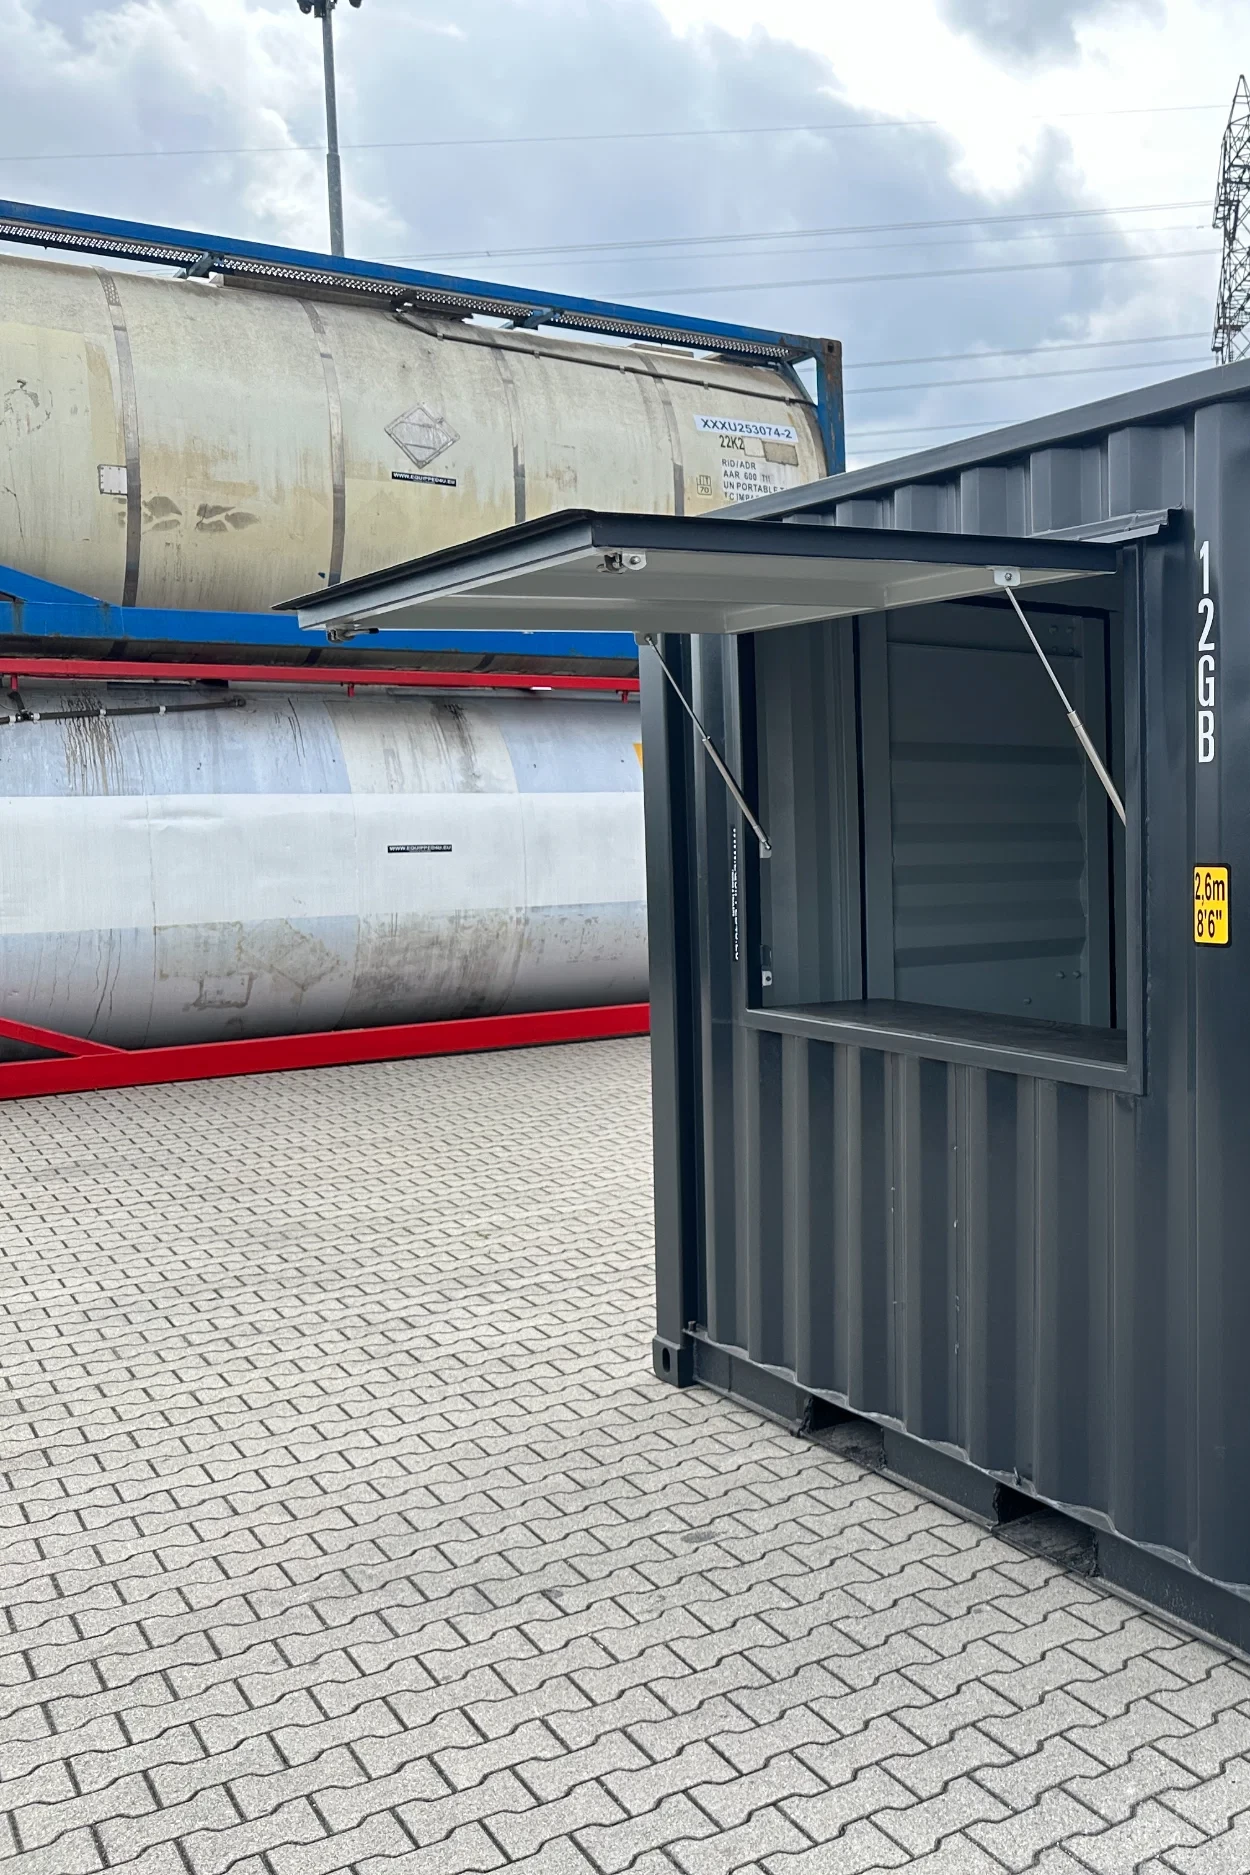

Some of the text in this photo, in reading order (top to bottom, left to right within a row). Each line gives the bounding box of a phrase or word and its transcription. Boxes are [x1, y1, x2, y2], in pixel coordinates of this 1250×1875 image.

[700, 417, 793, 439] XXXU253074-2
[718, 434, 745, 451] 22K2
[721, 458, 757, 471] RID/ADR
[723, 469, 740, 480] AAR
[743, 472, 757, 482] 600
[699, 486, 710, 494] 70
[723, 481, 735, 490] UN
[1197, 540, 1216, 763] 12GB
[1195, 871, 1225, 906] 2,6m
[1196, 908, 1223, 938] 8'6"
